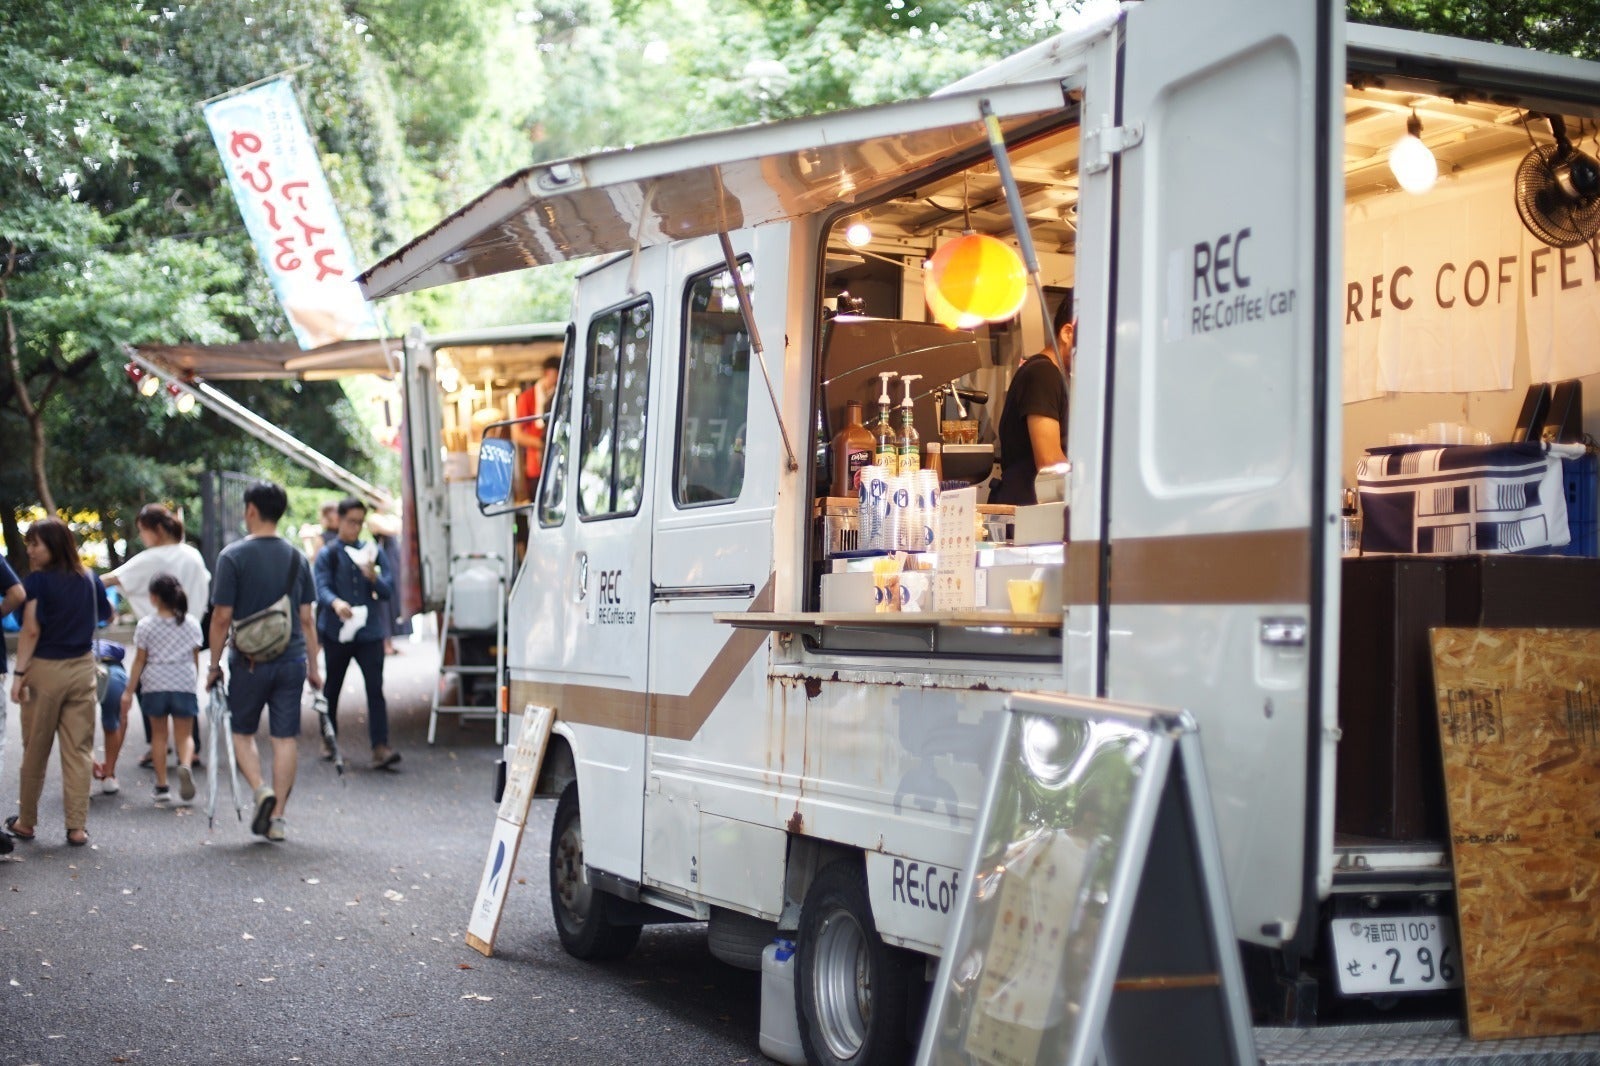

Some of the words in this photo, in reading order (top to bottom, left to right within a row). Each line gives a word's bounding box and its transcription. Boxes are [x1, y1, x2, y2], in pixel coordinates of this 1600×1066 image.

[1193, 227, 1252, 301] REC
[1346, 265, 1414, 325] REC
[1435, 231, 1600, 309] COFFE
[599, 570, 622, 604] REC
